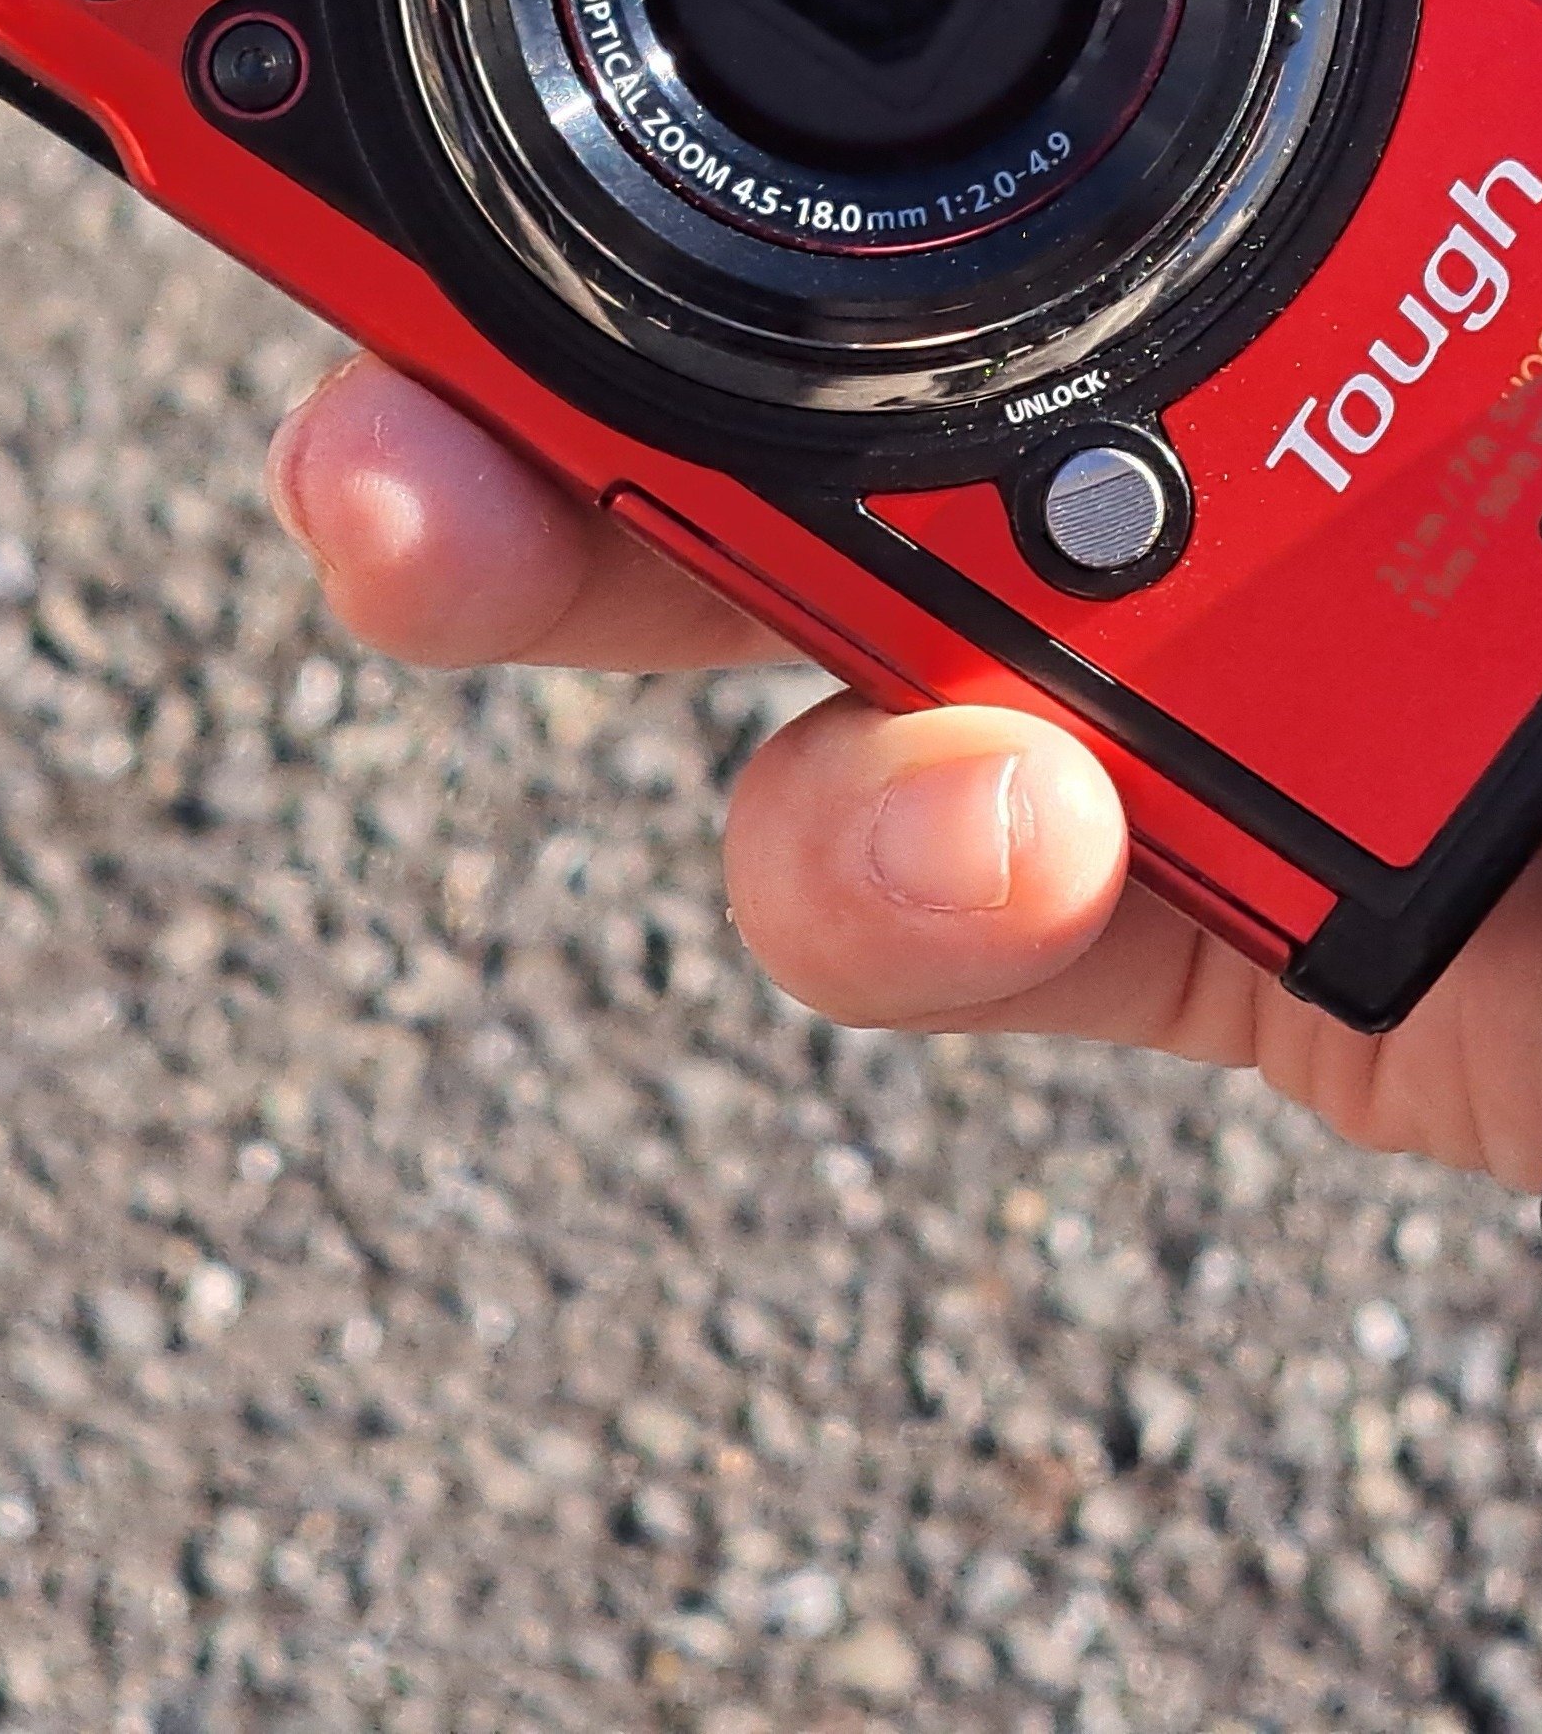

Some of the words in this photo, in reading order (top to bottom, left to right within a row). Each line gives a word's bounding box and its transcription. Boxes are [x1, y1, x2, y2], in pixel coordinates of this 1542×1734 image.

[641, 108, 732, 191] ZOOM
[935, 131, 1072, 223] 1:2.0-4.9
[1004, 368, 1107, 424] UNLOCK
